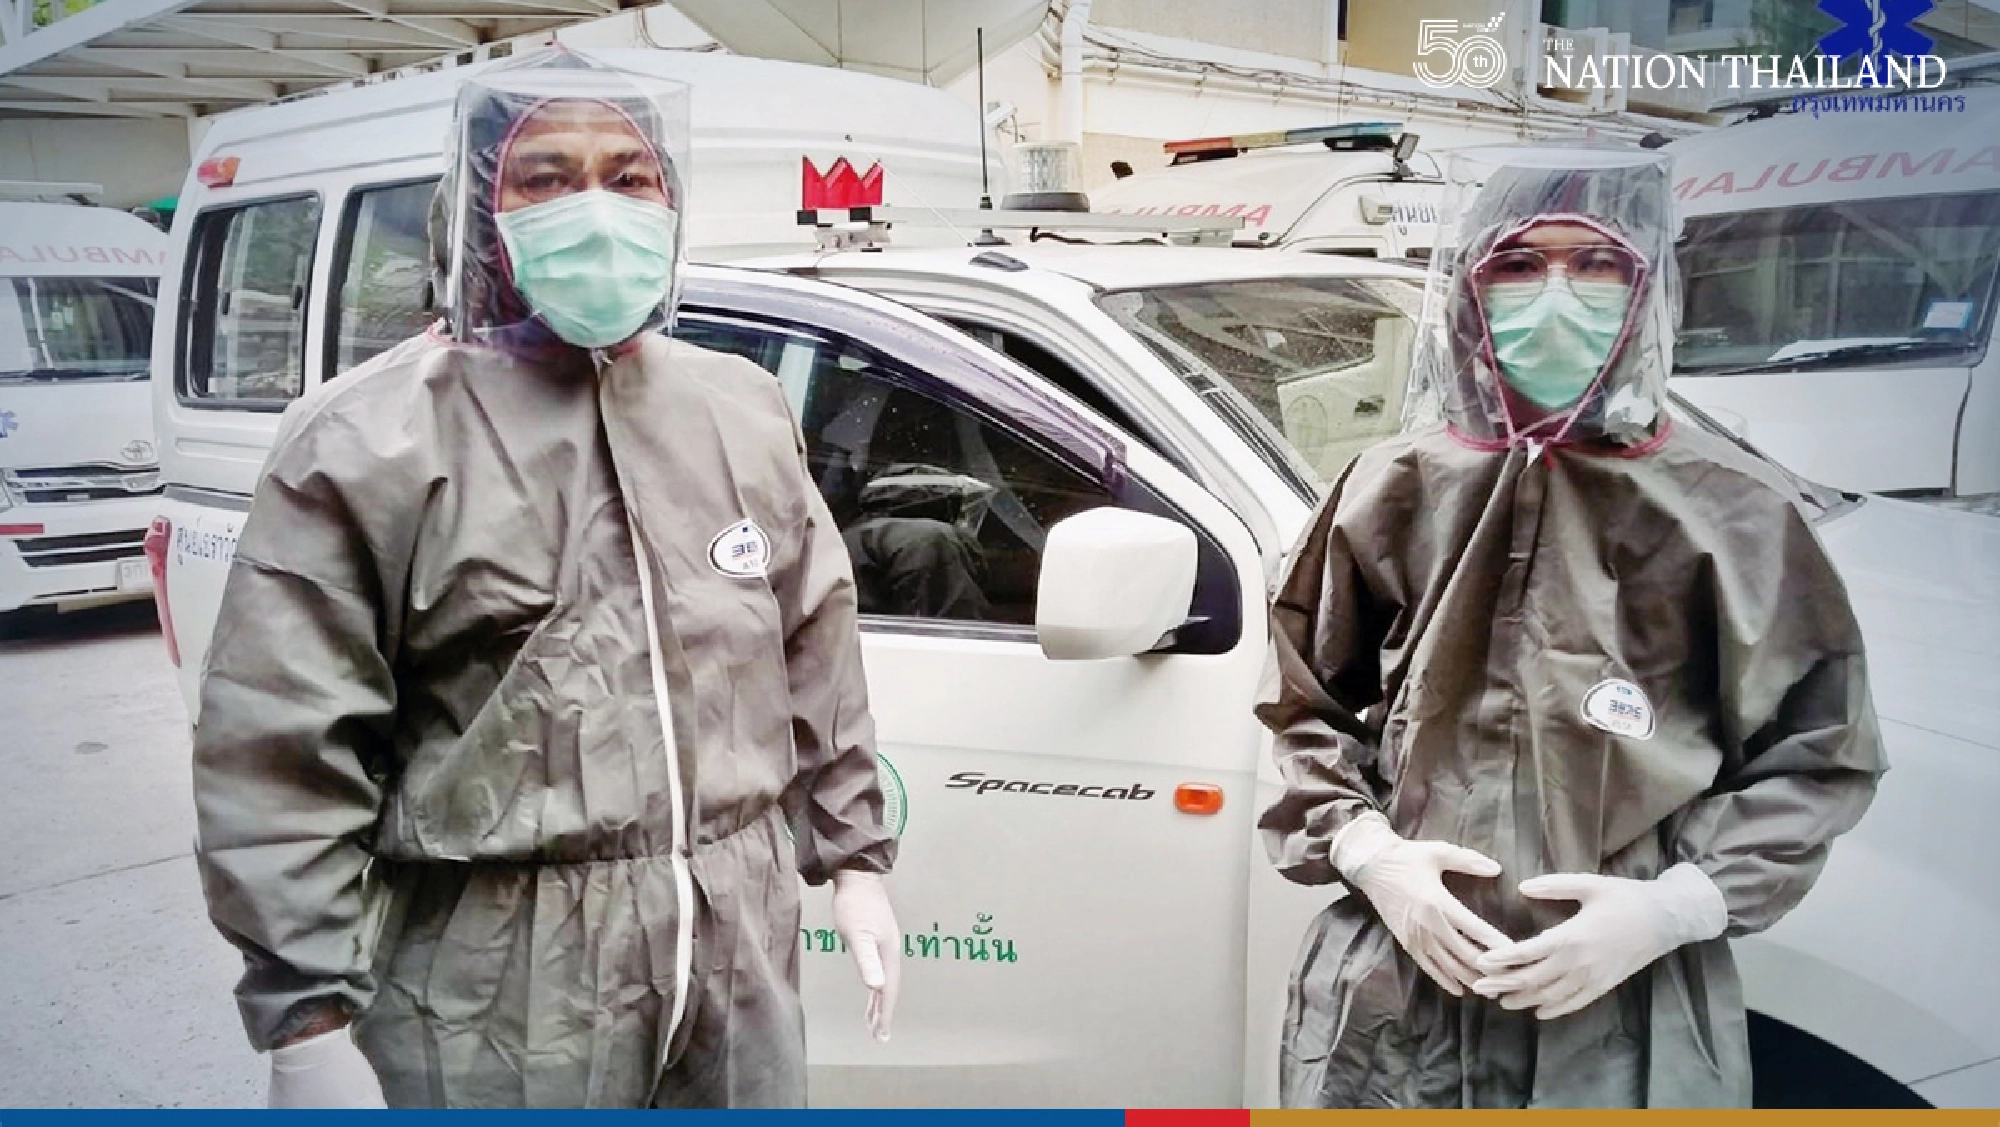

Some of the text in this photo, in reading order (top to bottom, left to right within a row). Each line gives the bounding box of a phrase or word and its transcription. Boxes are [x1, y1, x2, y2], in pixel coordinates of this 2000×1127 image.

[945, 772, 1156, 800] Spacecab
[904, 912, 1018, 963] เท่านั้น
